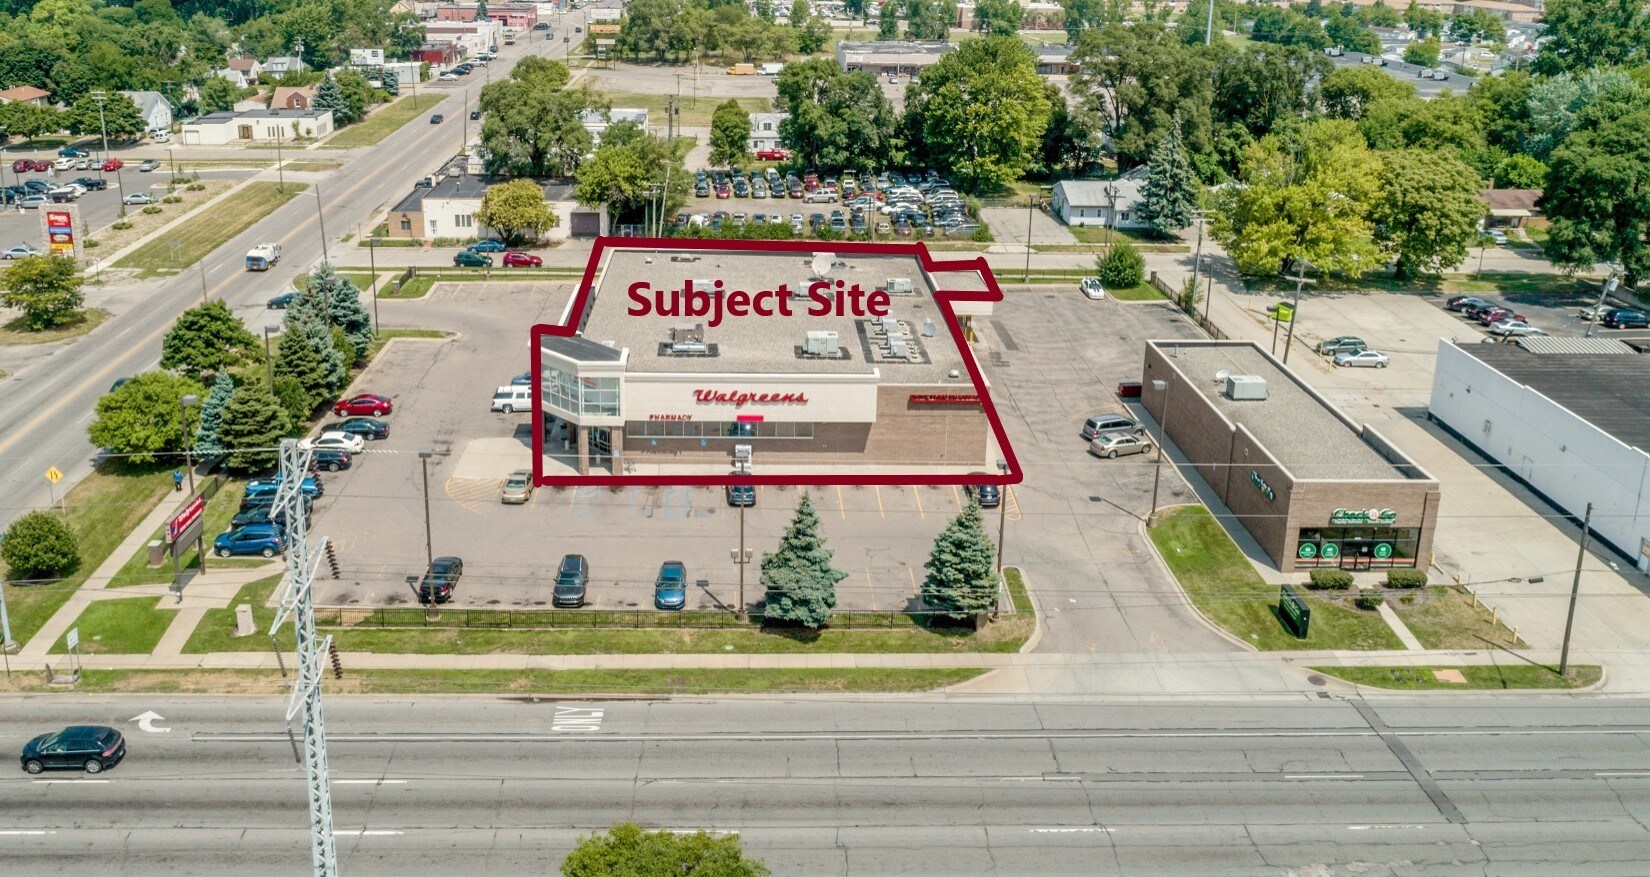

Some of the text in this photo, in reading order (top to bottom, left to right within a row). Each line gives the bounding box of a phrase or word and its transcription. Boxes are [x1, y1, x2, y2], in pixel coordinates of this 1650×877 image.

[692, 389, 809, 407] Walgreens
[649, 413, 693, 421] PHARMACY
[551, 706, 605, 731] ONLY
